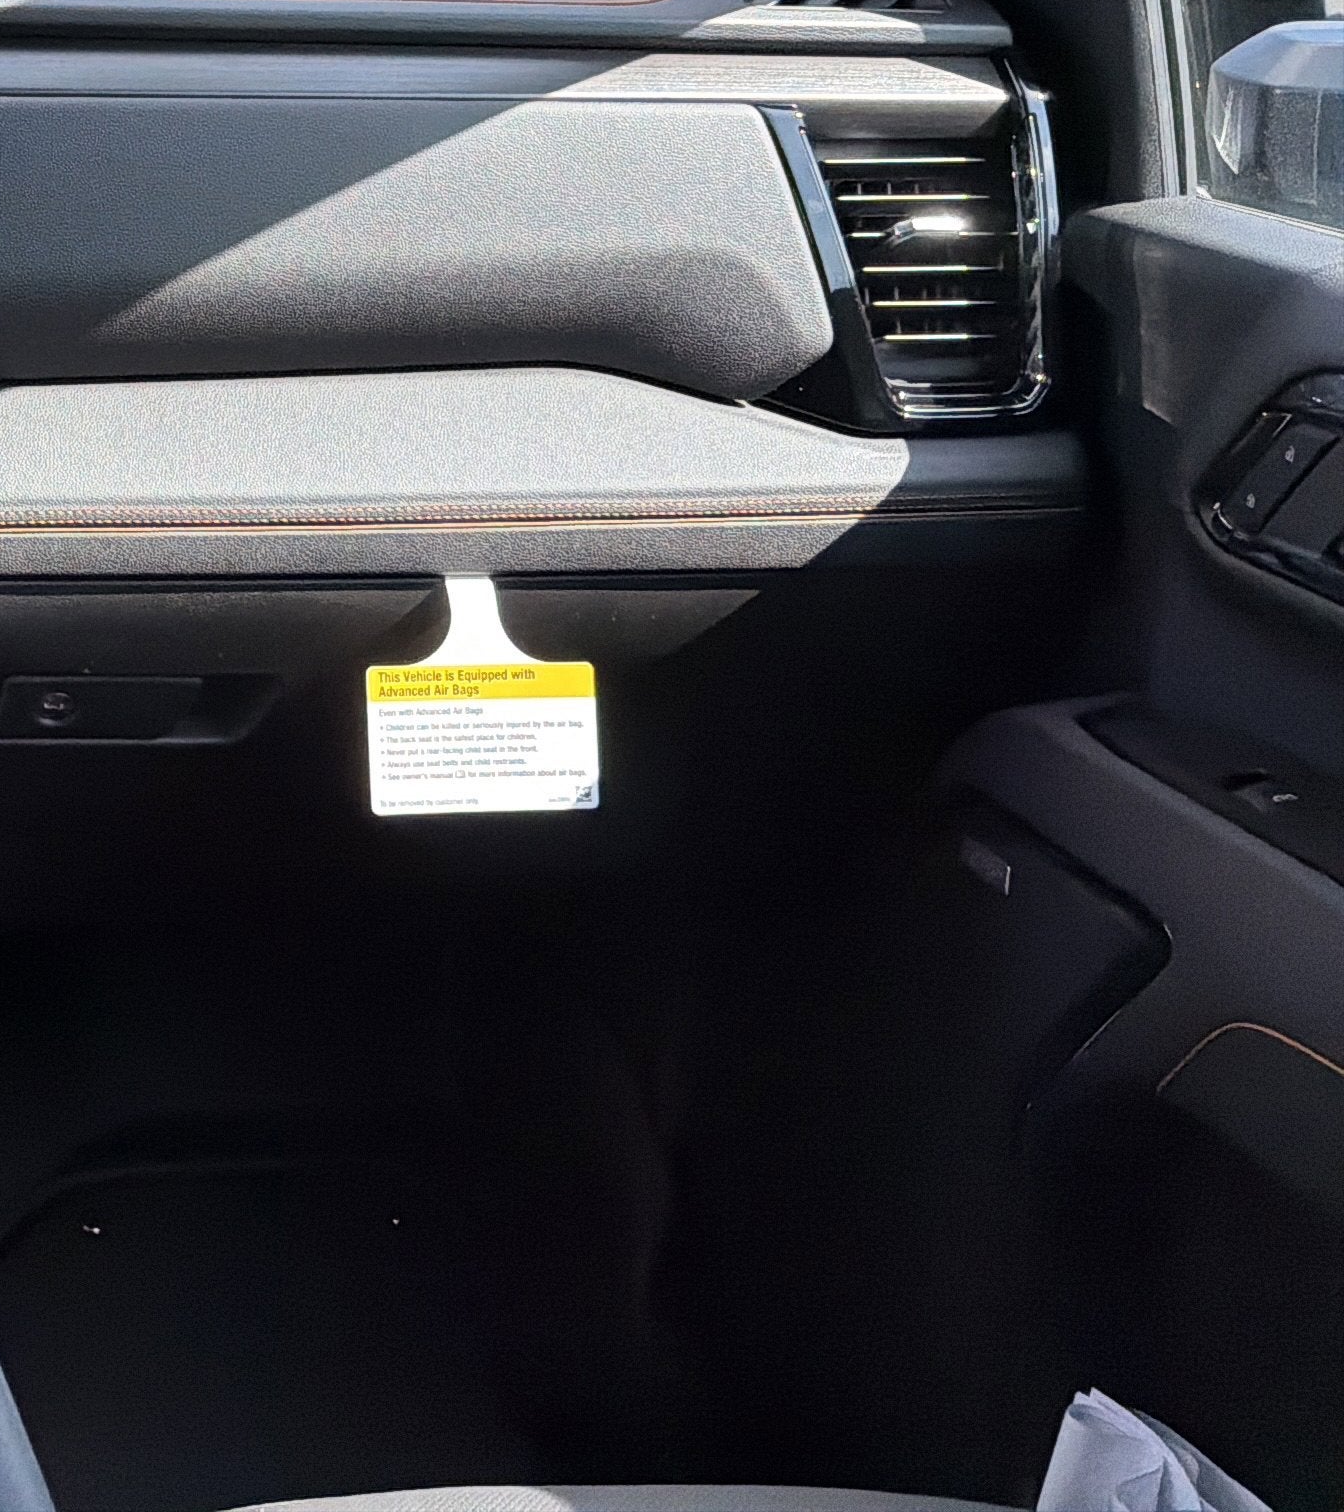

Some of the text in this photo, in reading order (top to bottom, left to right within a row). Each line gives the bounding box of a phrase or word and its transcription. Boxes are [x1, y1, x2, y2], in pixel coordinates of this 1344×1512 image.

[378, 668, 536, 683] This Vehicle is Equipped with
[378, 684, 480, 698] Advanced Air Bags
[379, 709, 396, 717] Even
[416, 708, 451, 716] Advanced
[453, 707, 463, 715] Air
[465, 707, 483, 716] Bags
